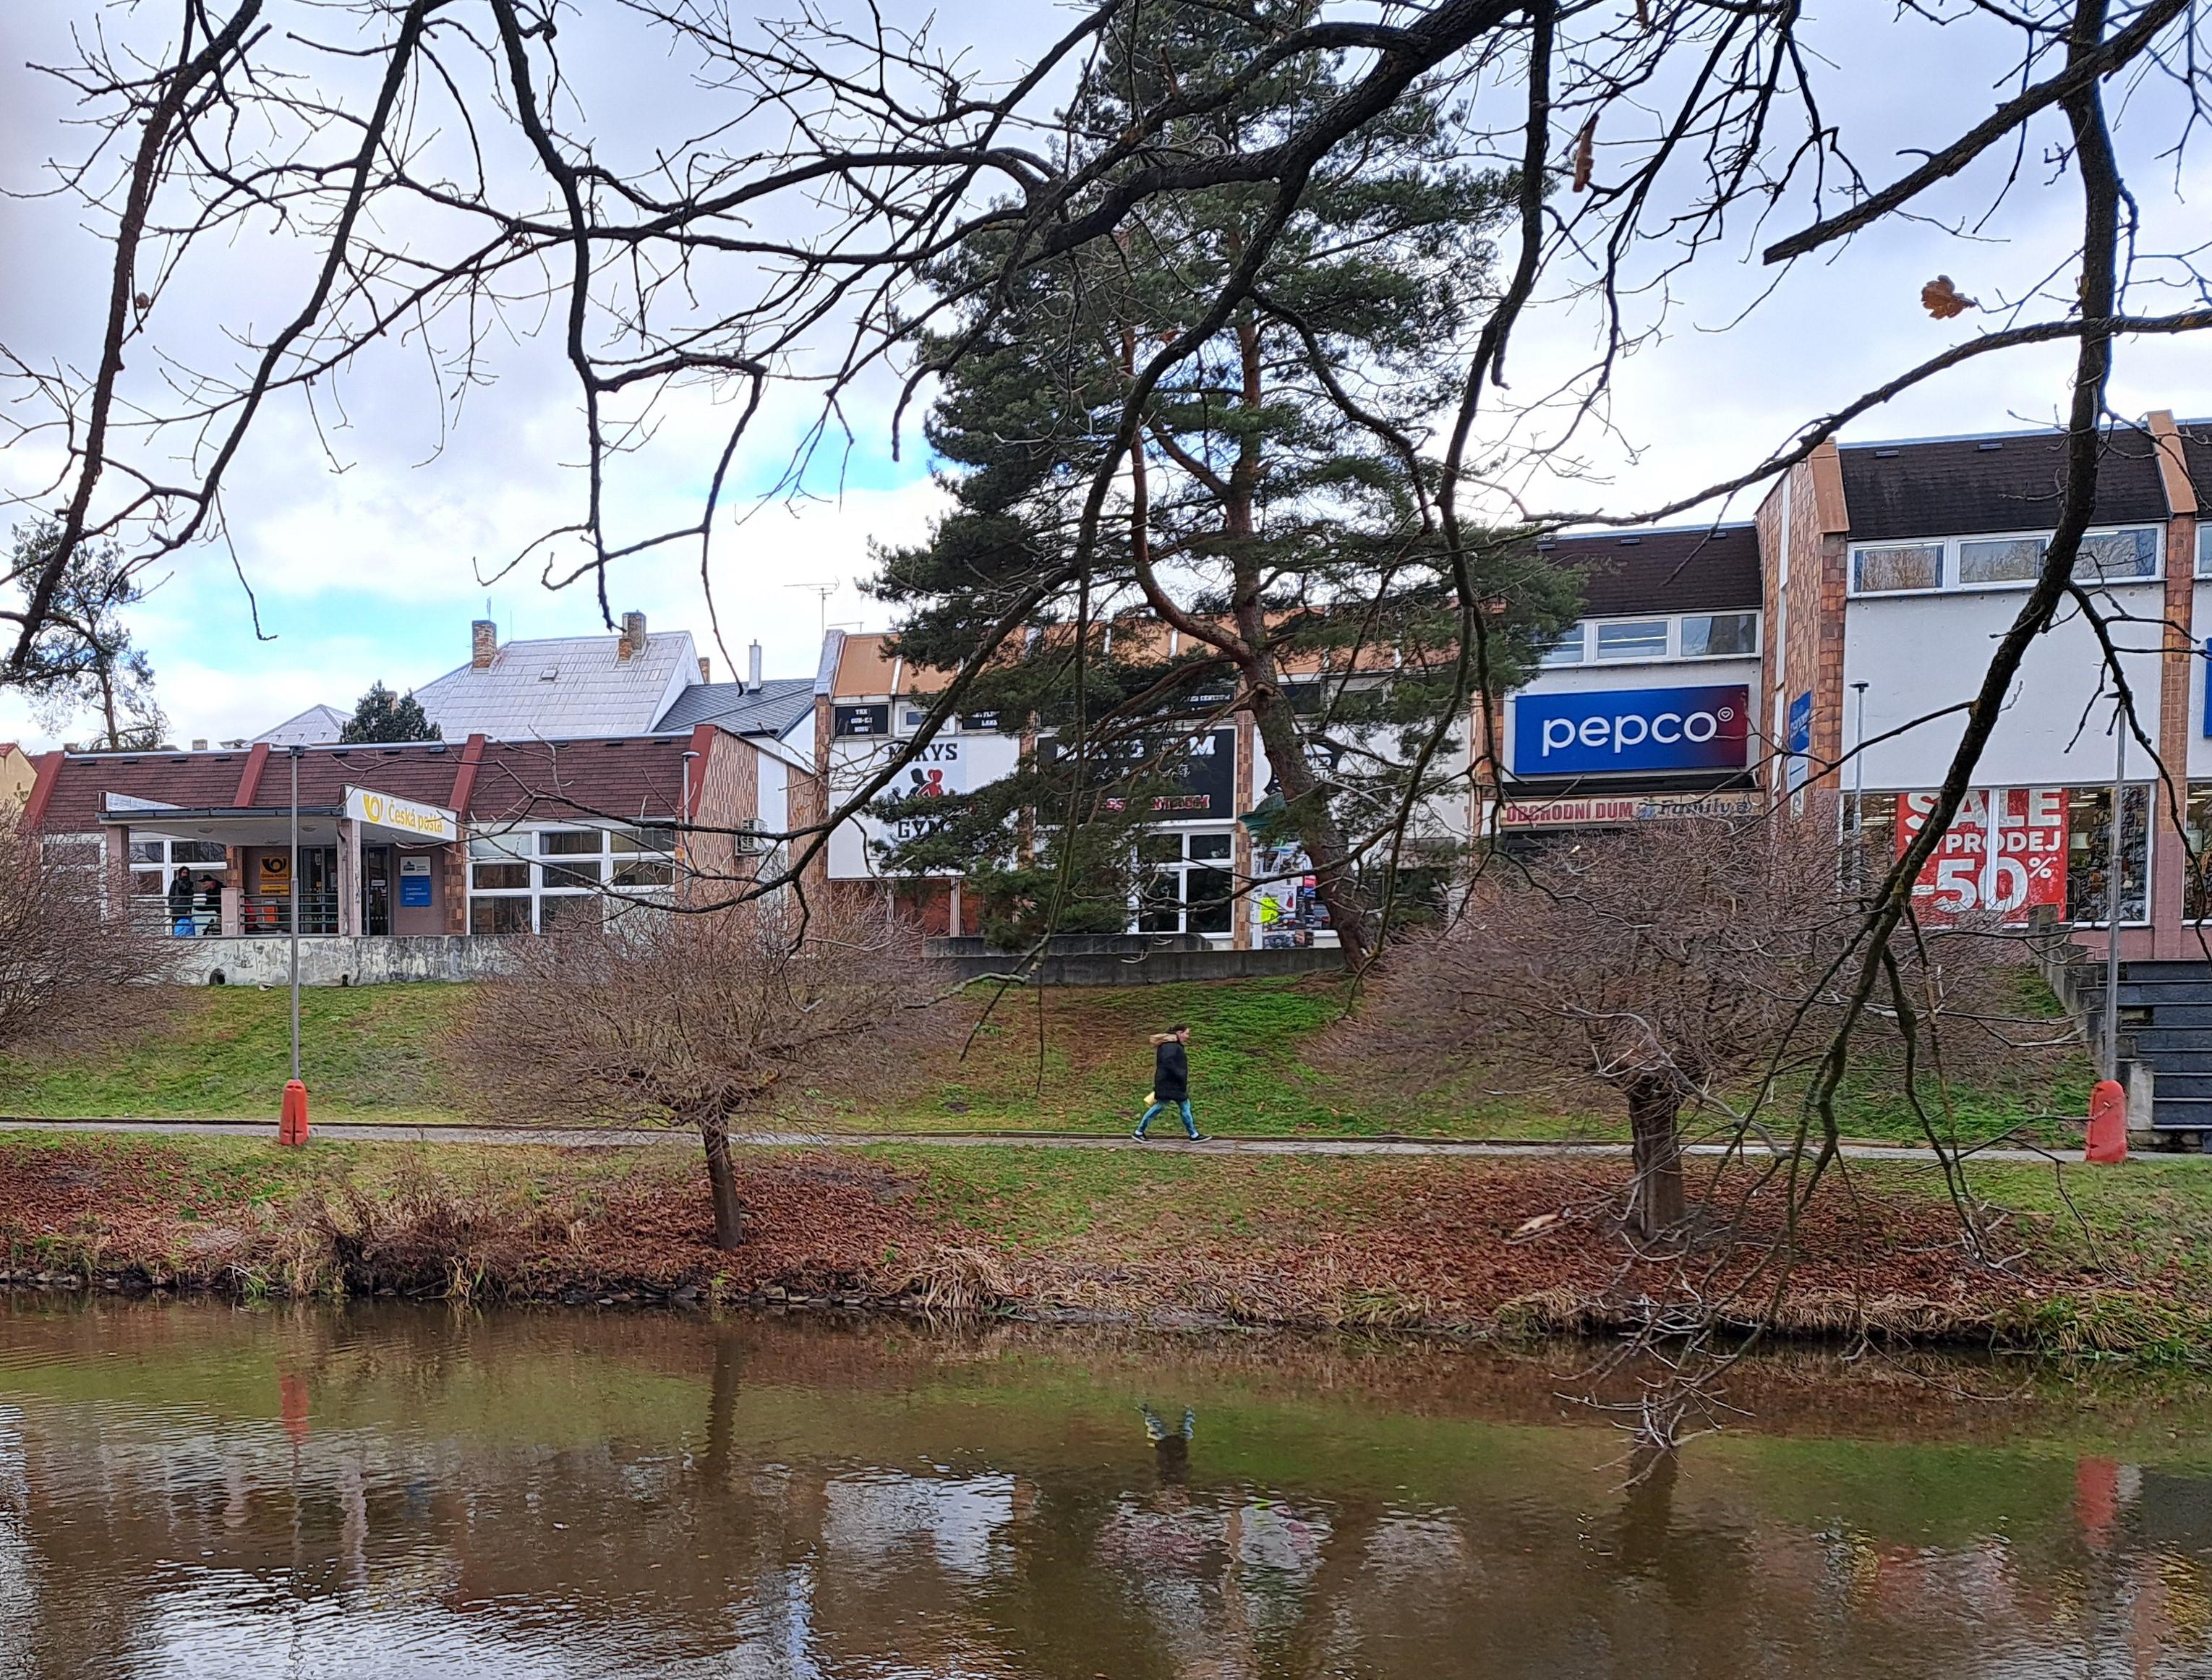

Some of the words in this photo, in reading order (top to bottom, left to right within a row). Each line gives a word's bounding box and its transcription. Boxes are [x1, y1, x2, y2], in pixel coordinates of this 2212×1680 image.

[1542, 712, 1717, 757] pepco
[388, 799, 416, 827] Česká
[417, 813, 443, 834] pošta
[1905, 788, 2062, 831] SALE
[1905, 831, 2061, 854] PRODEJ
